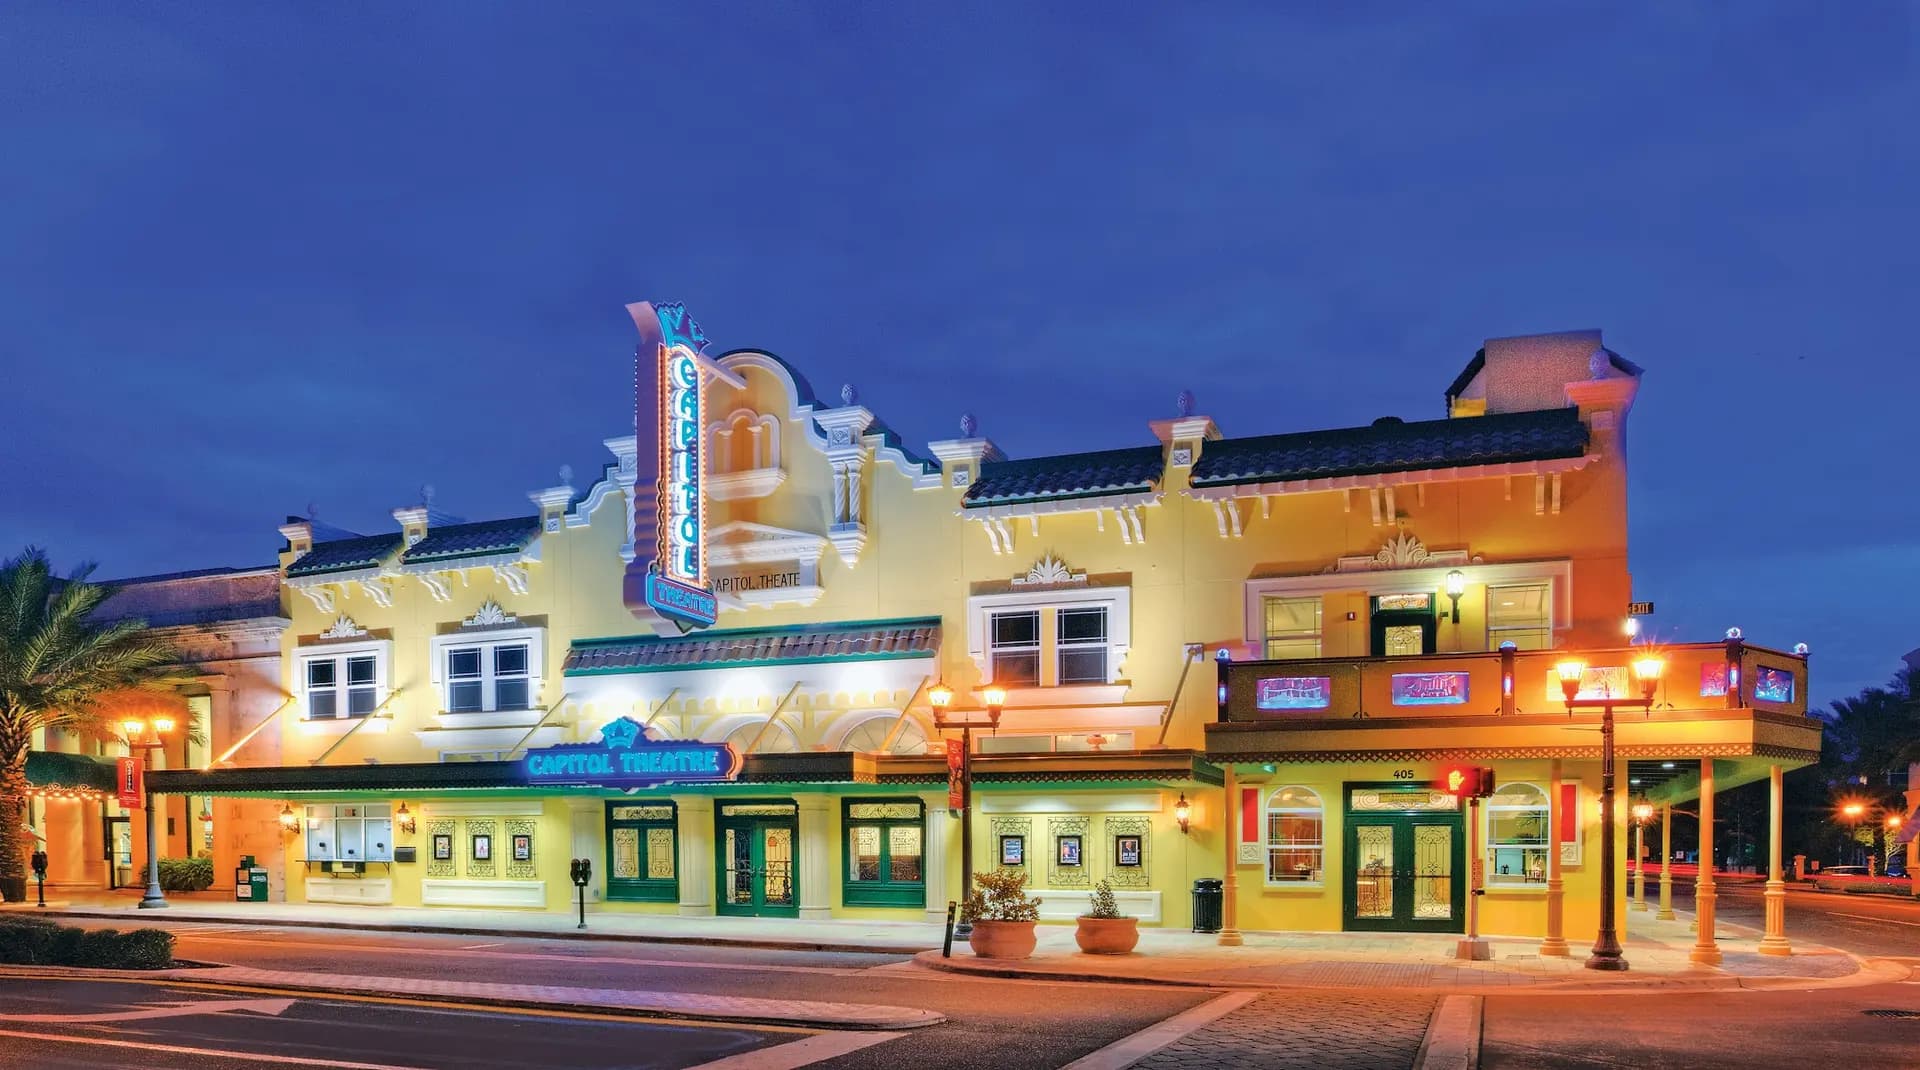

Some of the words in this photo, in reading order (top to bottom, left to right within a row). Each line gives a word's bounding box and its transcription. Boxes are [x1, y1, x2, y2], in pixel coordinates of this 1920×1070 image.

[671, 356, 698, 578] CAPITOL
[712, 575, 756, 593] APITOL
[759, 572, 801, 590] THEATE
[657, 582, 715, 616] THEATRE
[527, 751, 614, 775] CAPITOL
[619, 750, 719, 773] THEATRE
[1393, 769, 1414, 779] 405
